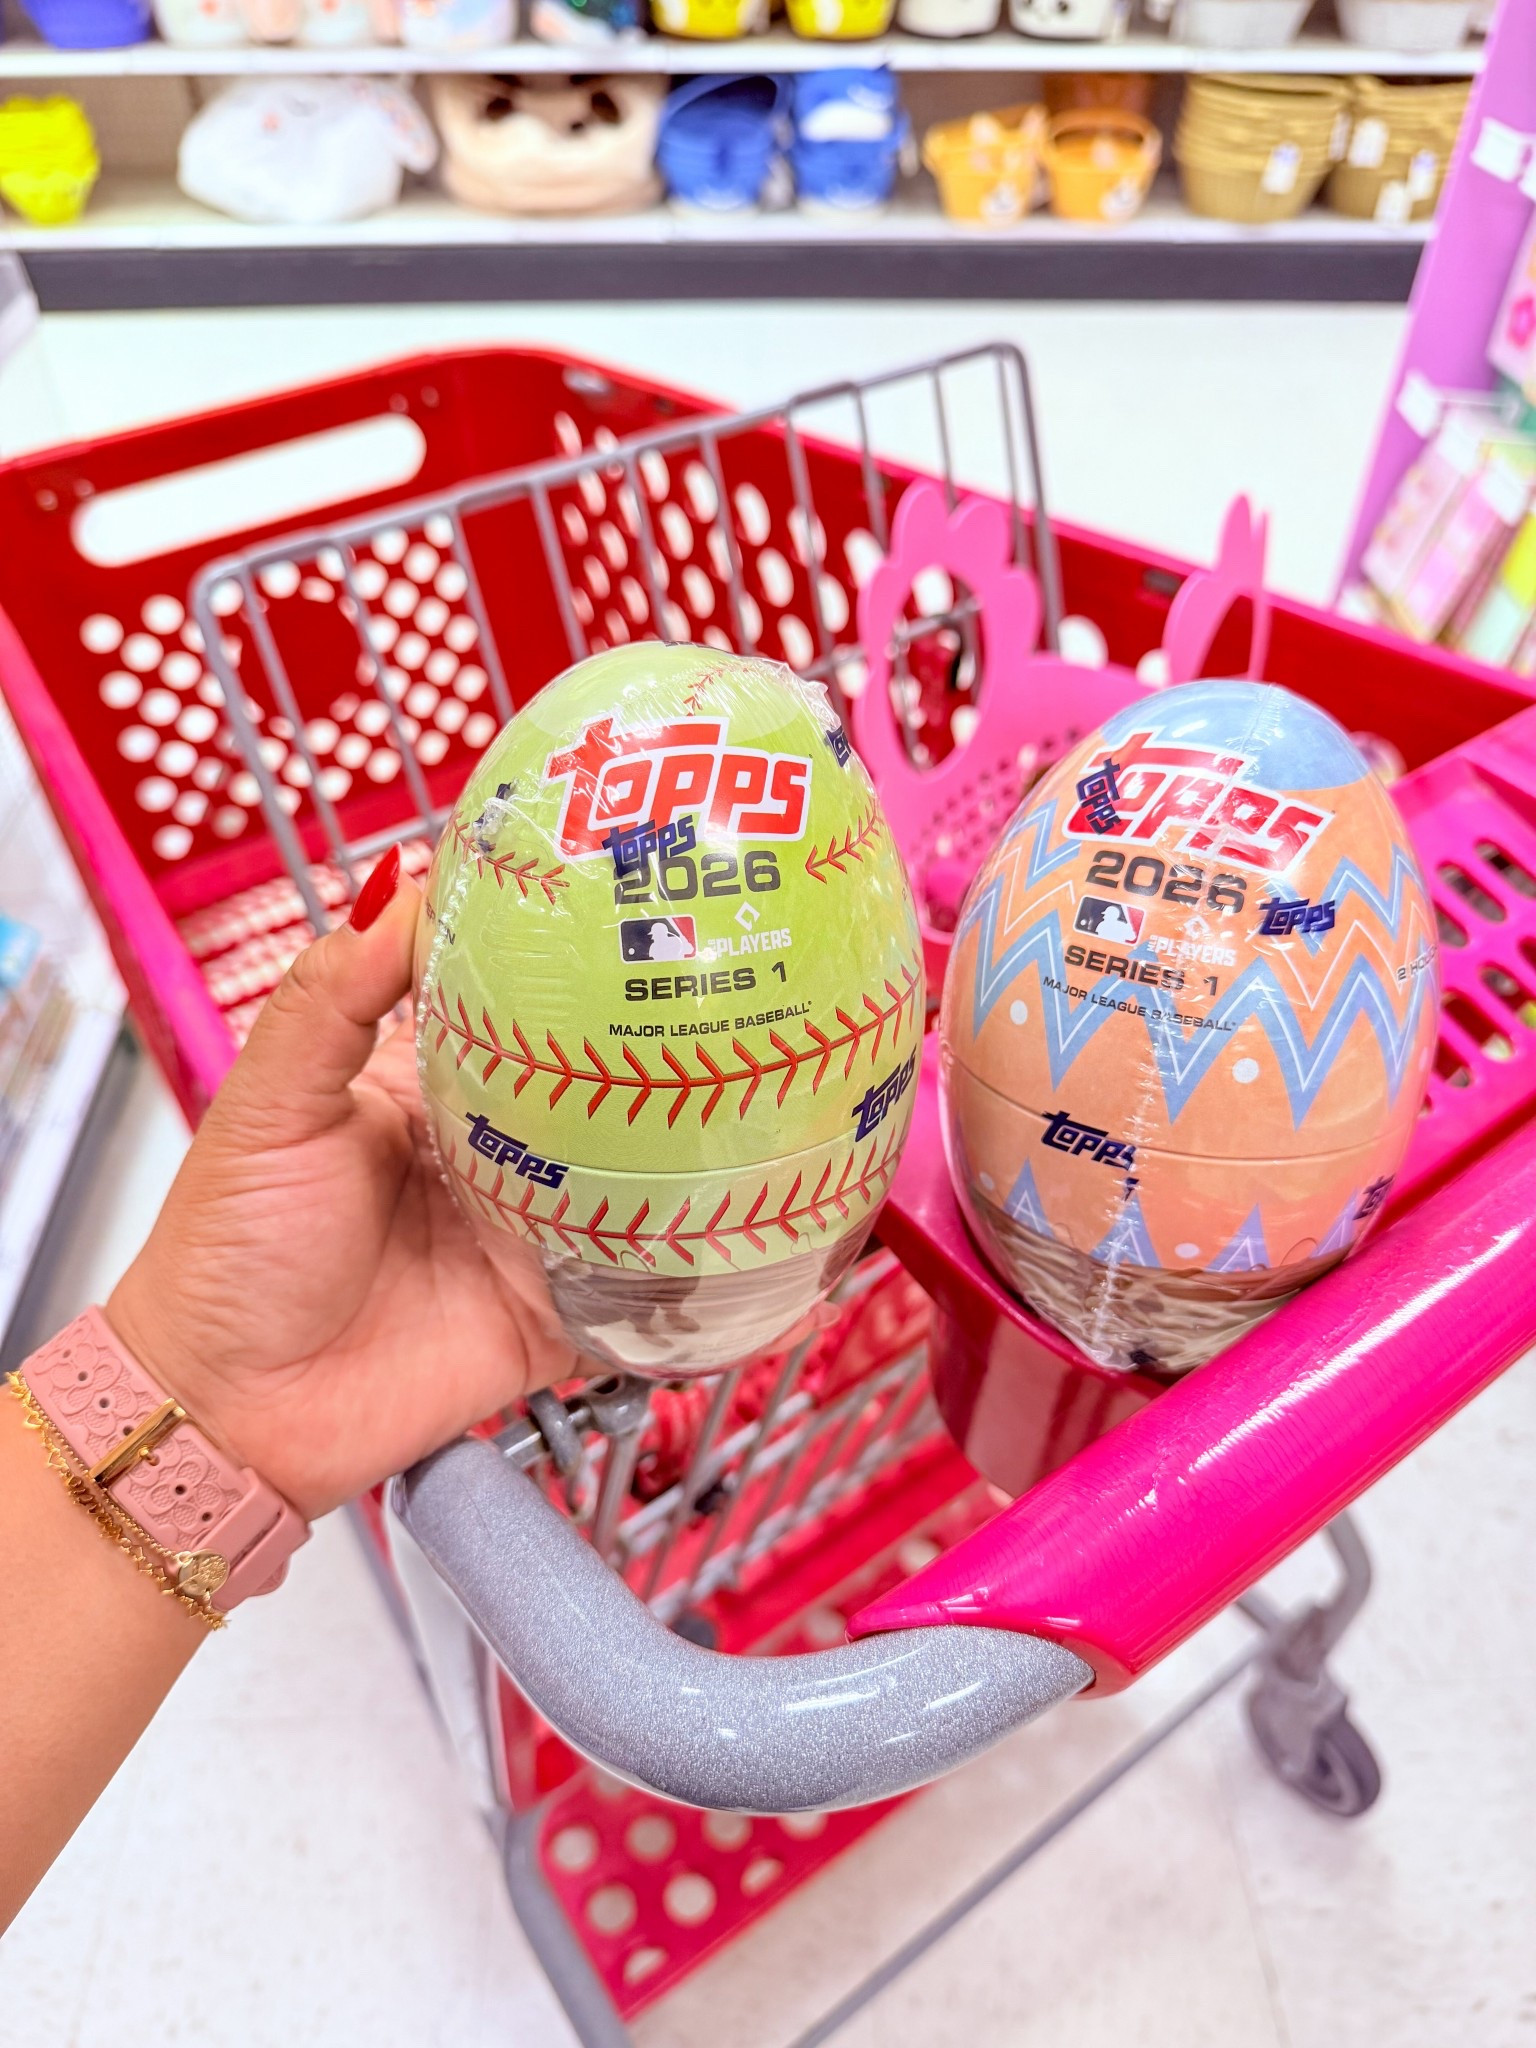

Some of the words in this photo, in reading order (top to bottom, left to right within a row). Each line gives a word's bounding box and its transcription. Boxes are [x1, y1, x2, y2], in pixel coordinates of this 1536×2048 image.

[613, 850, 782, 906] 2026
[1085, 850, 1248, 914] 2026
[716, 927, 793, 958] PLAYERS
[1154, 936, 1237, 968] PLAYERS
[624, 965, 758, 1002] SERIES
[770, 960, 790, 984] 1
[1064, 945, 1185, 990] SERIES
[1203, 975, 1219, 996] 1
[608, 1023, 667, 1038] MAJOR
[669, 1019, 731, 1038] LEAGUE
[734, 1002, 811, 1030] BASEBALL
[1043, 976, 1088, 1001] MAJOR
[1091, 994, 1146, 1017] LEAGUE
[1151, 1009, 1235, 1032] BASEBALL
